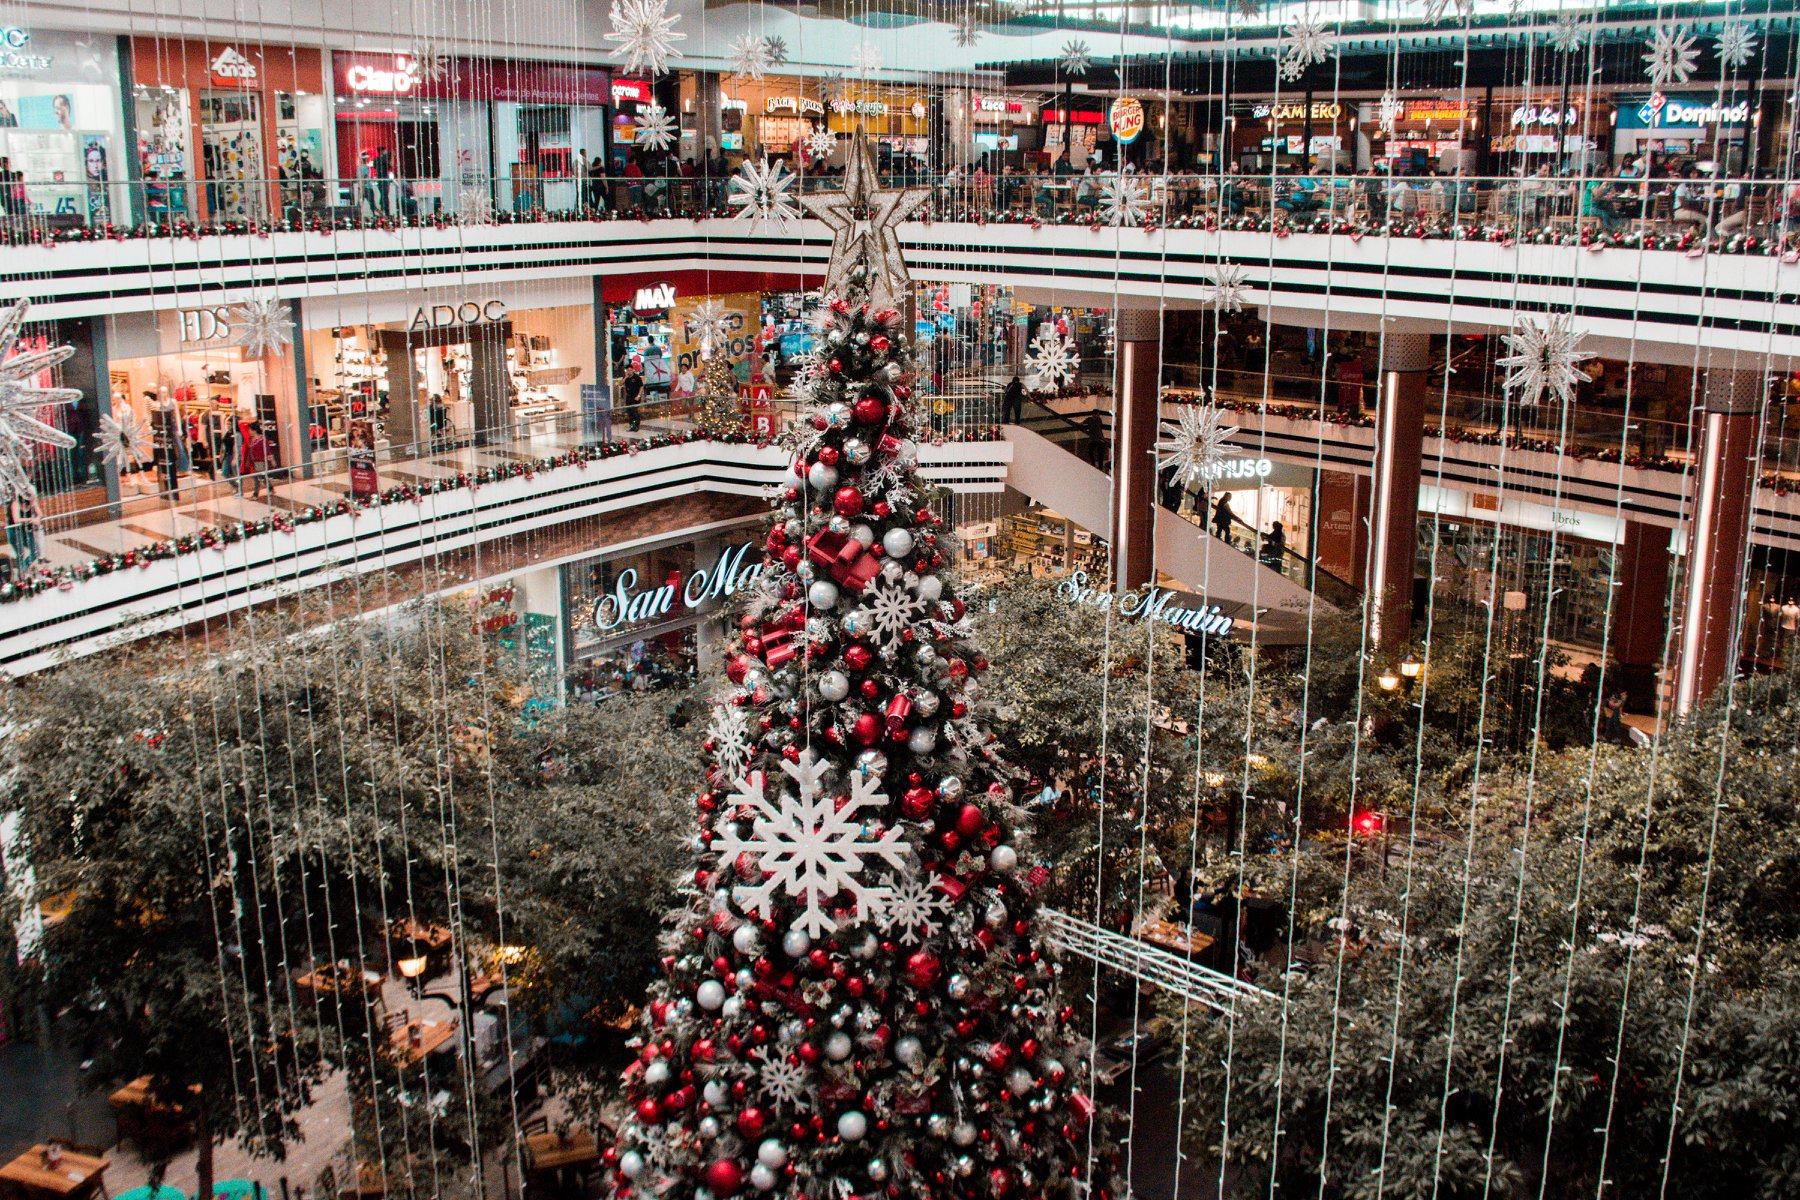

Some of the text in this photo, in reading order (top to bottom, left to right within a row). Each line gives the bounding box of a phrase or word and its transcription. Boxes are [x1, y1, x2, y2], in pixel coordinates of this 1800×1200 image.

[348, 63, 412, 92] Claro
[1113, 114, 1141, 134] KNG
[1271, 104, 1342, 119] CAMERO
[634, 283, 677, 310] MAX
[409, 300, 507, 331] ADOC
[1551, 510, 1581, 526] lbros
[595, 567, 676, 631] San
